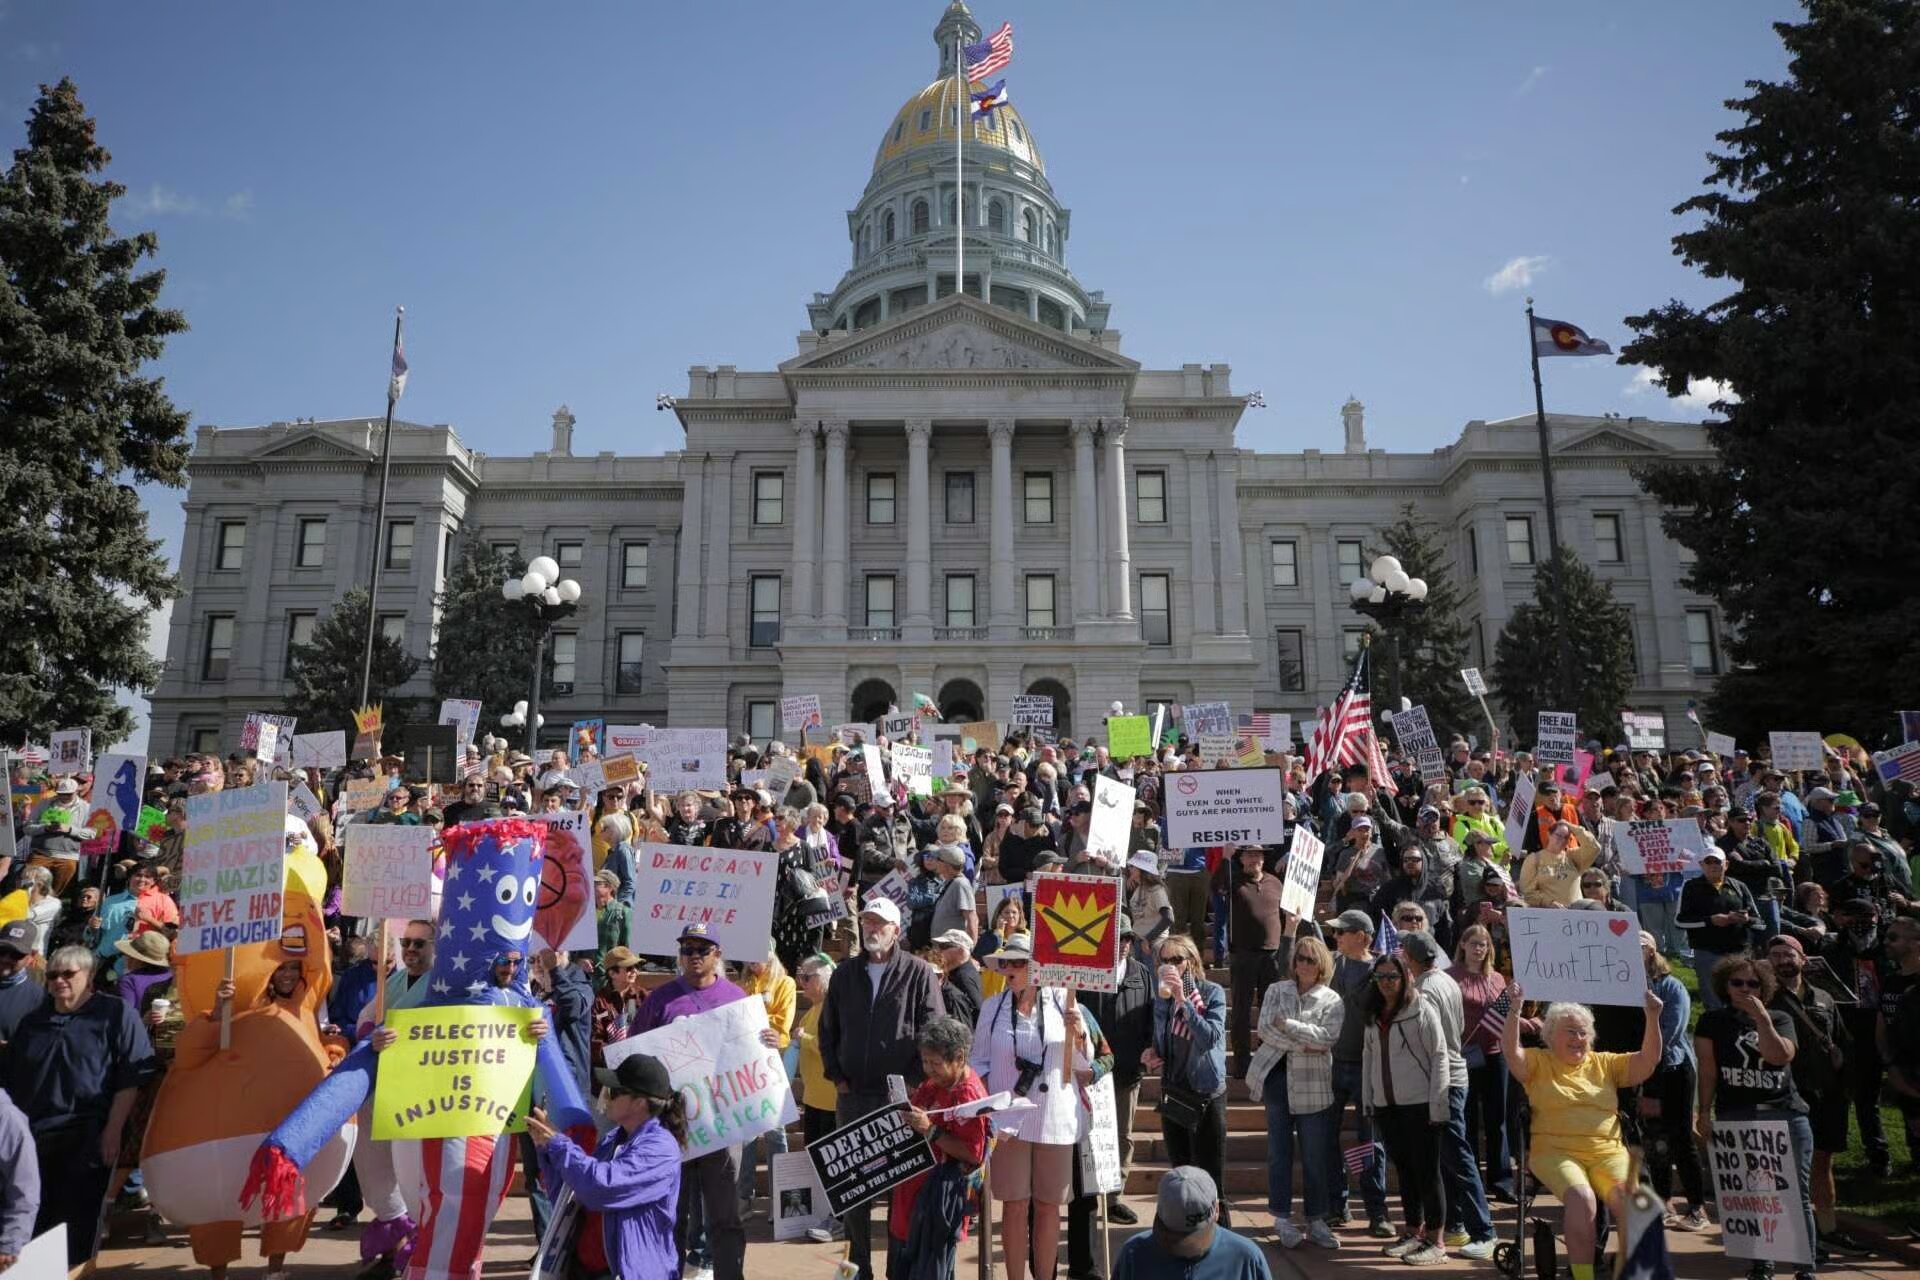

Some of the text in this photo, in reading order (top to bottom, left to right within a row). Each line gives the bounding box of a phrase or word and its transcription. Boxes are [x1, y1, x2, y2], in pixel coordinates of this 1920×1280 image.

[1016, 714, 1052, 725] RADICAL
[1415, 720, 1429, 731] THE
[1540, 715, 1573, 727] FREE ALL
[1540, 740, 1573, 751] POLITICAL
[1420, 752, 1441, 763] FIGHT
[1221, 806, 1275, 815] PROTESTING
[1629, 820, 1665, 830] SUPER
[1192, 829, 1251, 843] RESIST
[652, 852, 763, 876] DEMOCRACY
[1645, 860, 1684, 873] POTUS
[180, 864, 279, 900] NO NAZIS
[660, 879, 741, 899] DIES IN
[248, 892, 282, 920] HAD
[650, 903, 737, 924] SILENCE
[201, 920, 280, 950] ENOUGH!
[1520, 917, 1599, 936] I am
[1039, 969, 1106, 985] DUMP TRUMP
[409, 1024, 517, 1041] SELECTIVE
[419, 1049, 506, 1066] JUSTICE
[452, 1075, 472, 1091] IS
[704, 1055, 783, 1113] KINGS
[1721, 1066, 1785, 1089] RESIST
[394, 1095, 517, 1128] INJUSTICE
[819, 1109, 906, 1166] DEFUND
[1712, 1129, 1789, 1156] NO KING
[826, 1125, 915, 1178] OLIGARCHS
[1716, 1151, 1783, 1172] NO DON
[840, 1184, 867, 1203] FUND
[867, 1171, 889, 1189] THE
[887, 1153, 927, 1178] PEOPLE
[1719, 1174, 1743, 1191] NO
[1722, 1196, 1783, 1214] ORANGE
[1726, 1217, 1761, 1236] CON
